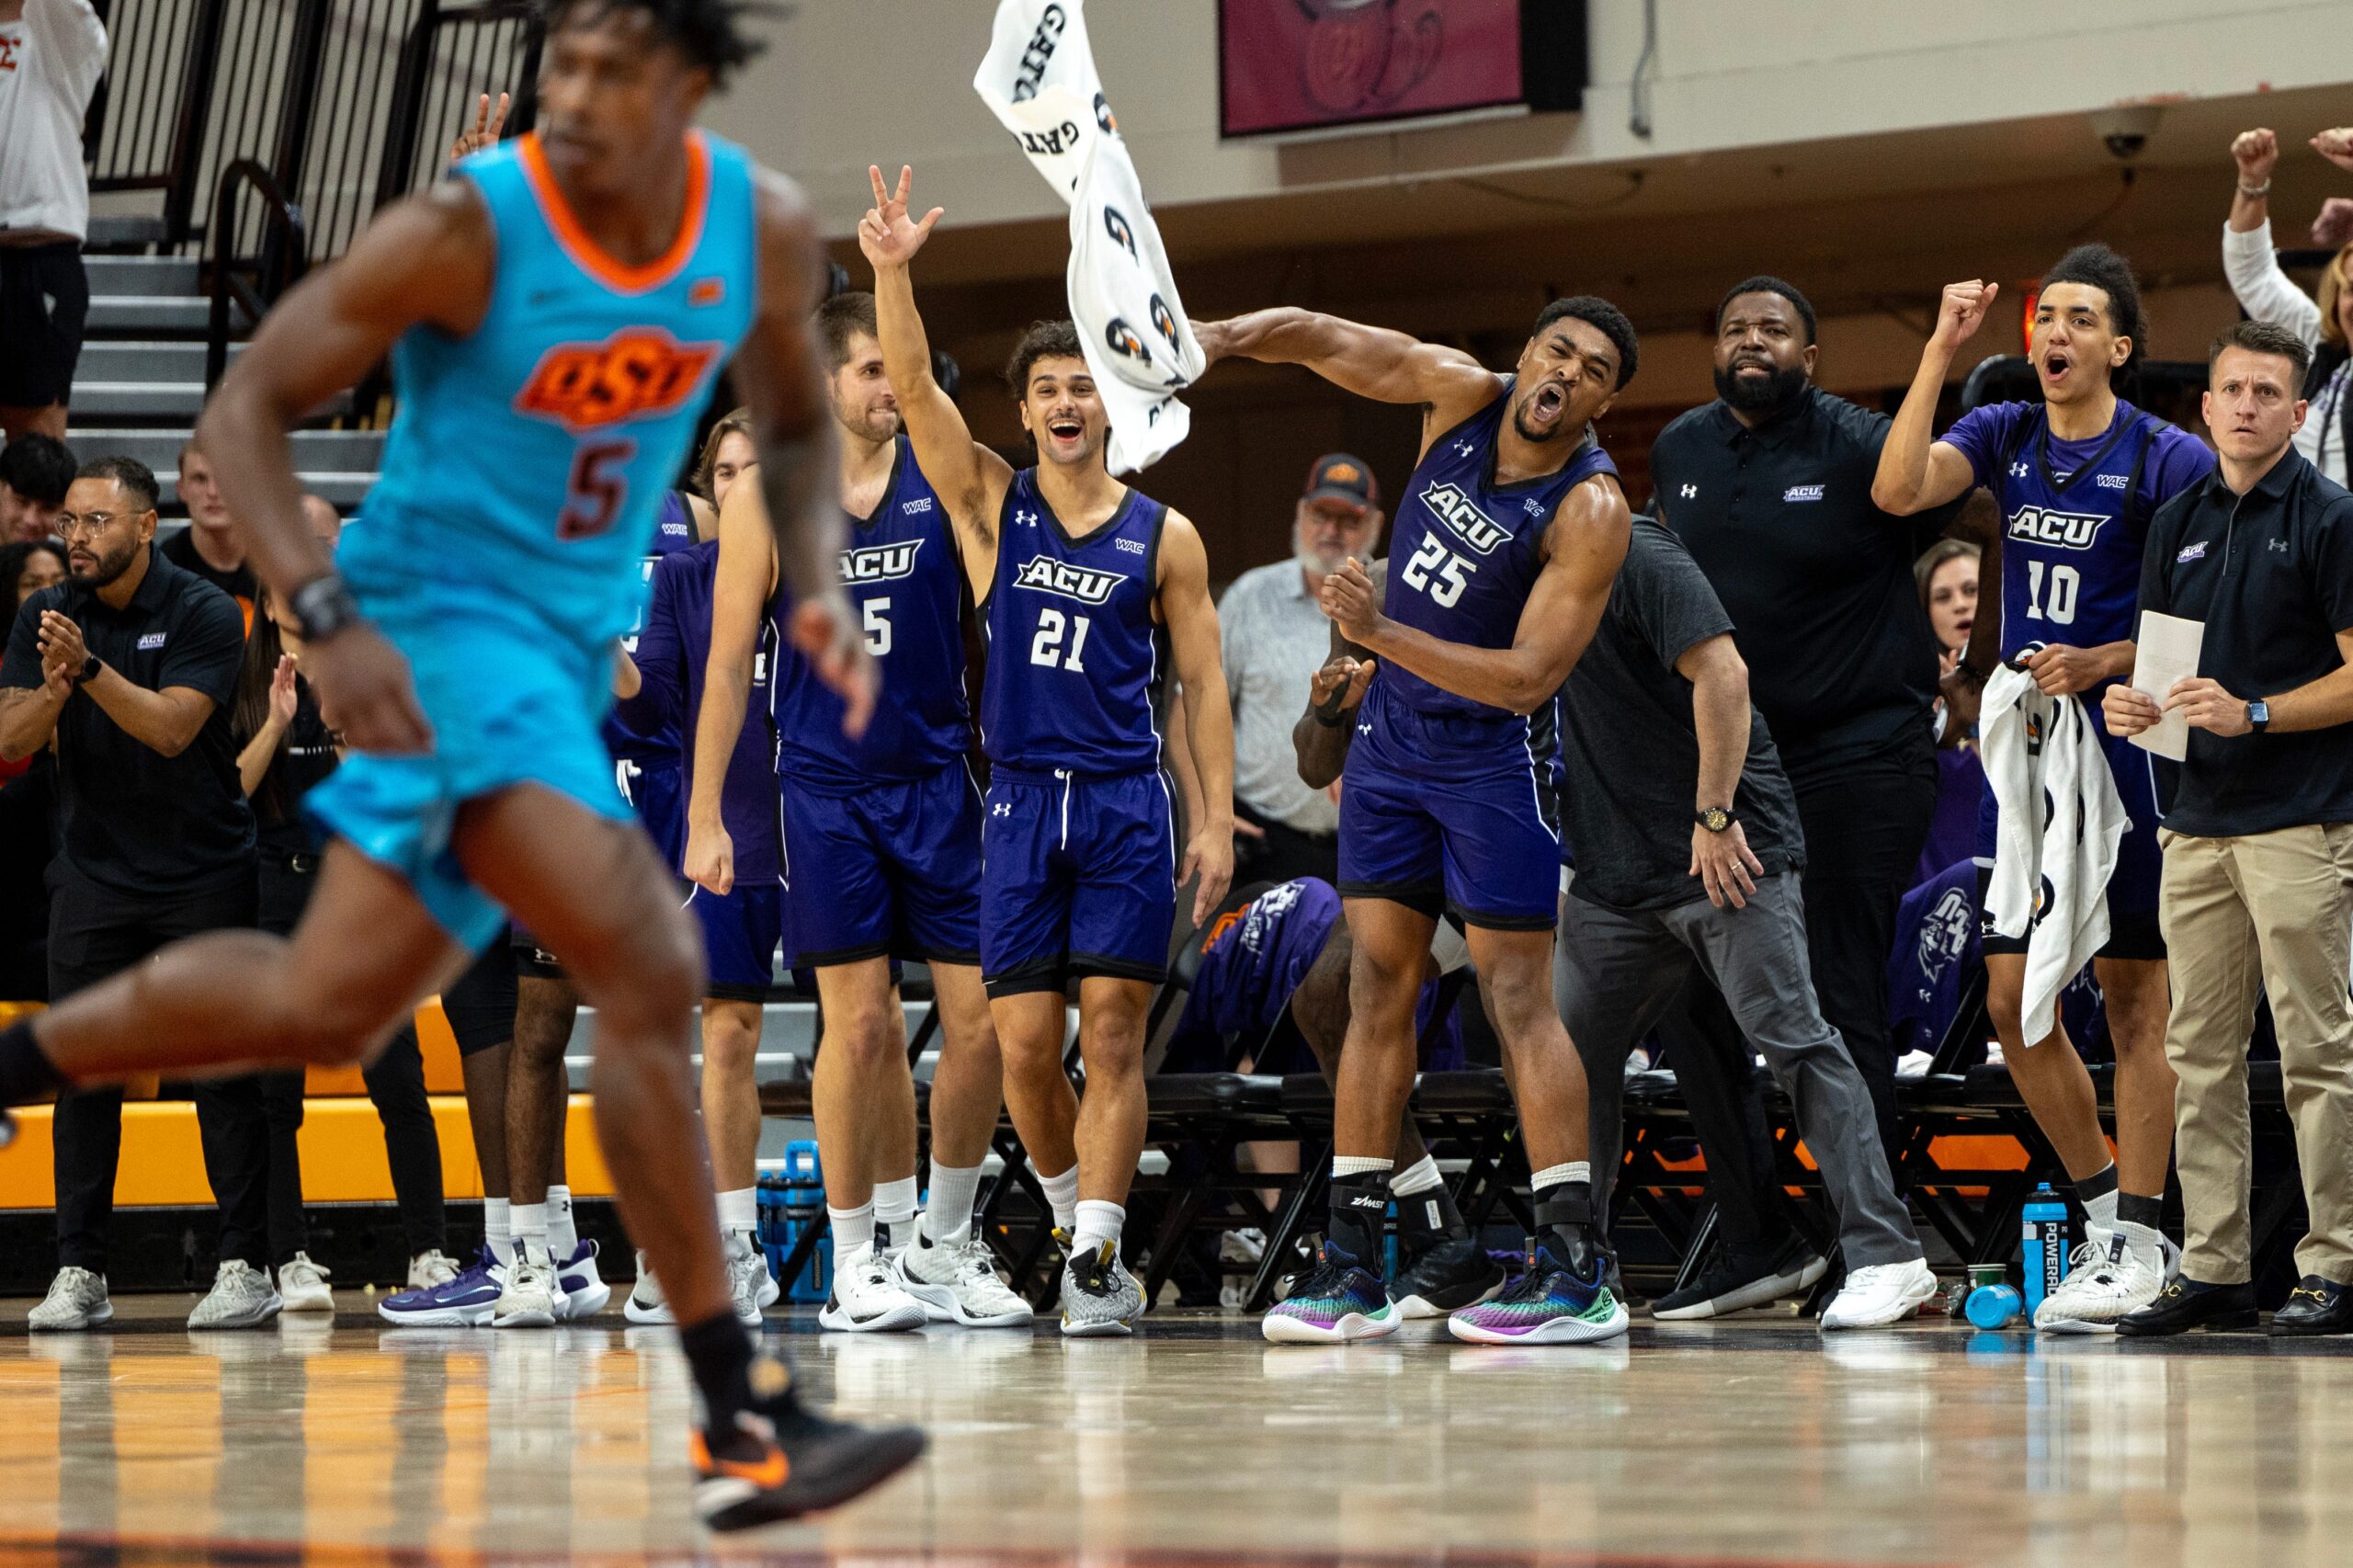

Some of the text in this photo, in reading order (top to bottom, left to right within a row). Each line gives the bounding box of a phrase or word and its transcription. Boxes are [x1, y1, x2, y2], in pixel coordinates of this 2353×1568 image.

[1012, 121, 1080, 155] GAT
[558, 439, 636, 540] 5
[1787, 486, 1821, 497] ACU
[2097, 474, 2129, 489] WAC
[903, 497, 931, 515] WAC
[1427, 487, 1506, 551] ACU
[662, 523, 688, 535] WAC
[1115, 538, 1145, 555] WAC
[2010, 509, 2102, 546] ACU
[838, 544, 915, 583] ACU
[1021, 559, 1117, 602] ACU
[1402, 530, 1477, 608] 25
[2026, 560, 2080, 625] 10
[864, 597, 892, 656] 5
[1030, 608, 1091, 673] 21
[1350, 1195, 1385, 1210] ZAMST
